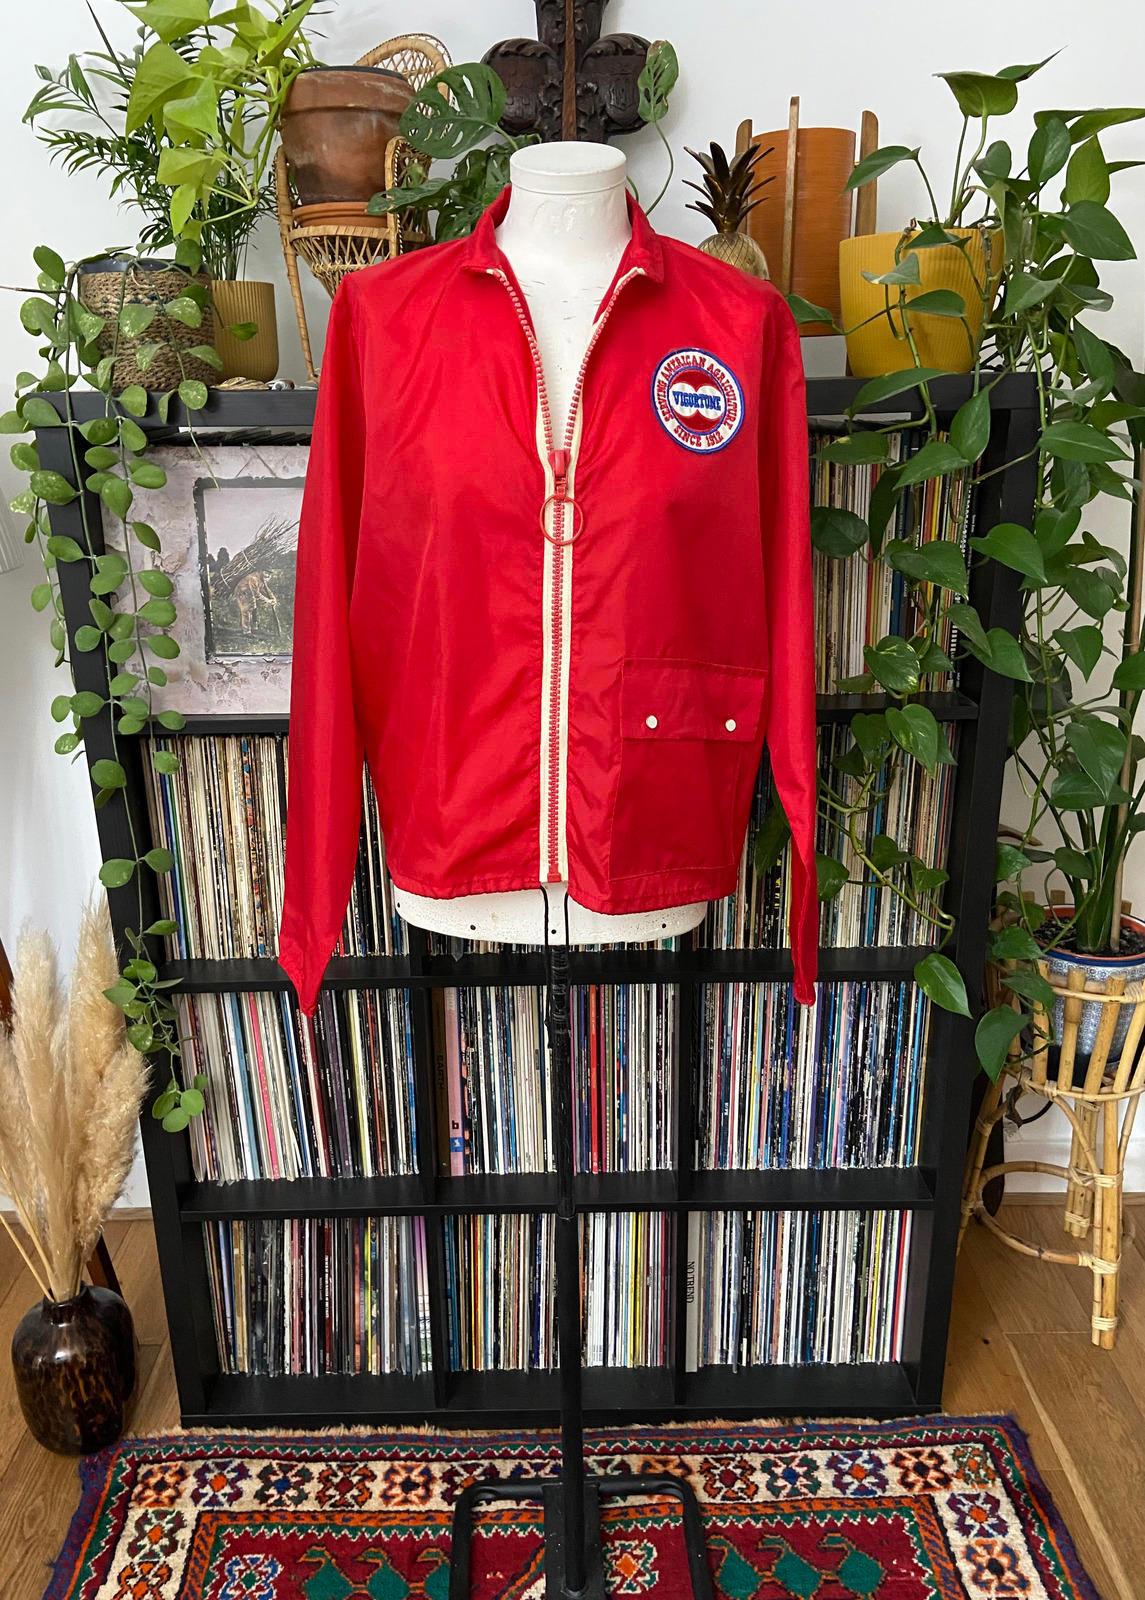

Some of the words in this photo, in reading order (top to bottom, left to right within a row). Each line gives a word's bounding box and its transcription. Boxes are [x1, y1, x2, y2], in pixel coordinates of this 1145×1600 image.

[661, 355, 706, 381] AMERICAN
[657, 379, 673, 421] SERVING
[672, 391, 721, 410] VIGORTONE
[707, 364, 737, 429] AGRICULTURE
[674, 425, 701, 446] SINCE
[705, 431, 723, 446] 1912
[687, 1261, 695, 1274] NO
[686, 1275, 695, 1304] TREND
